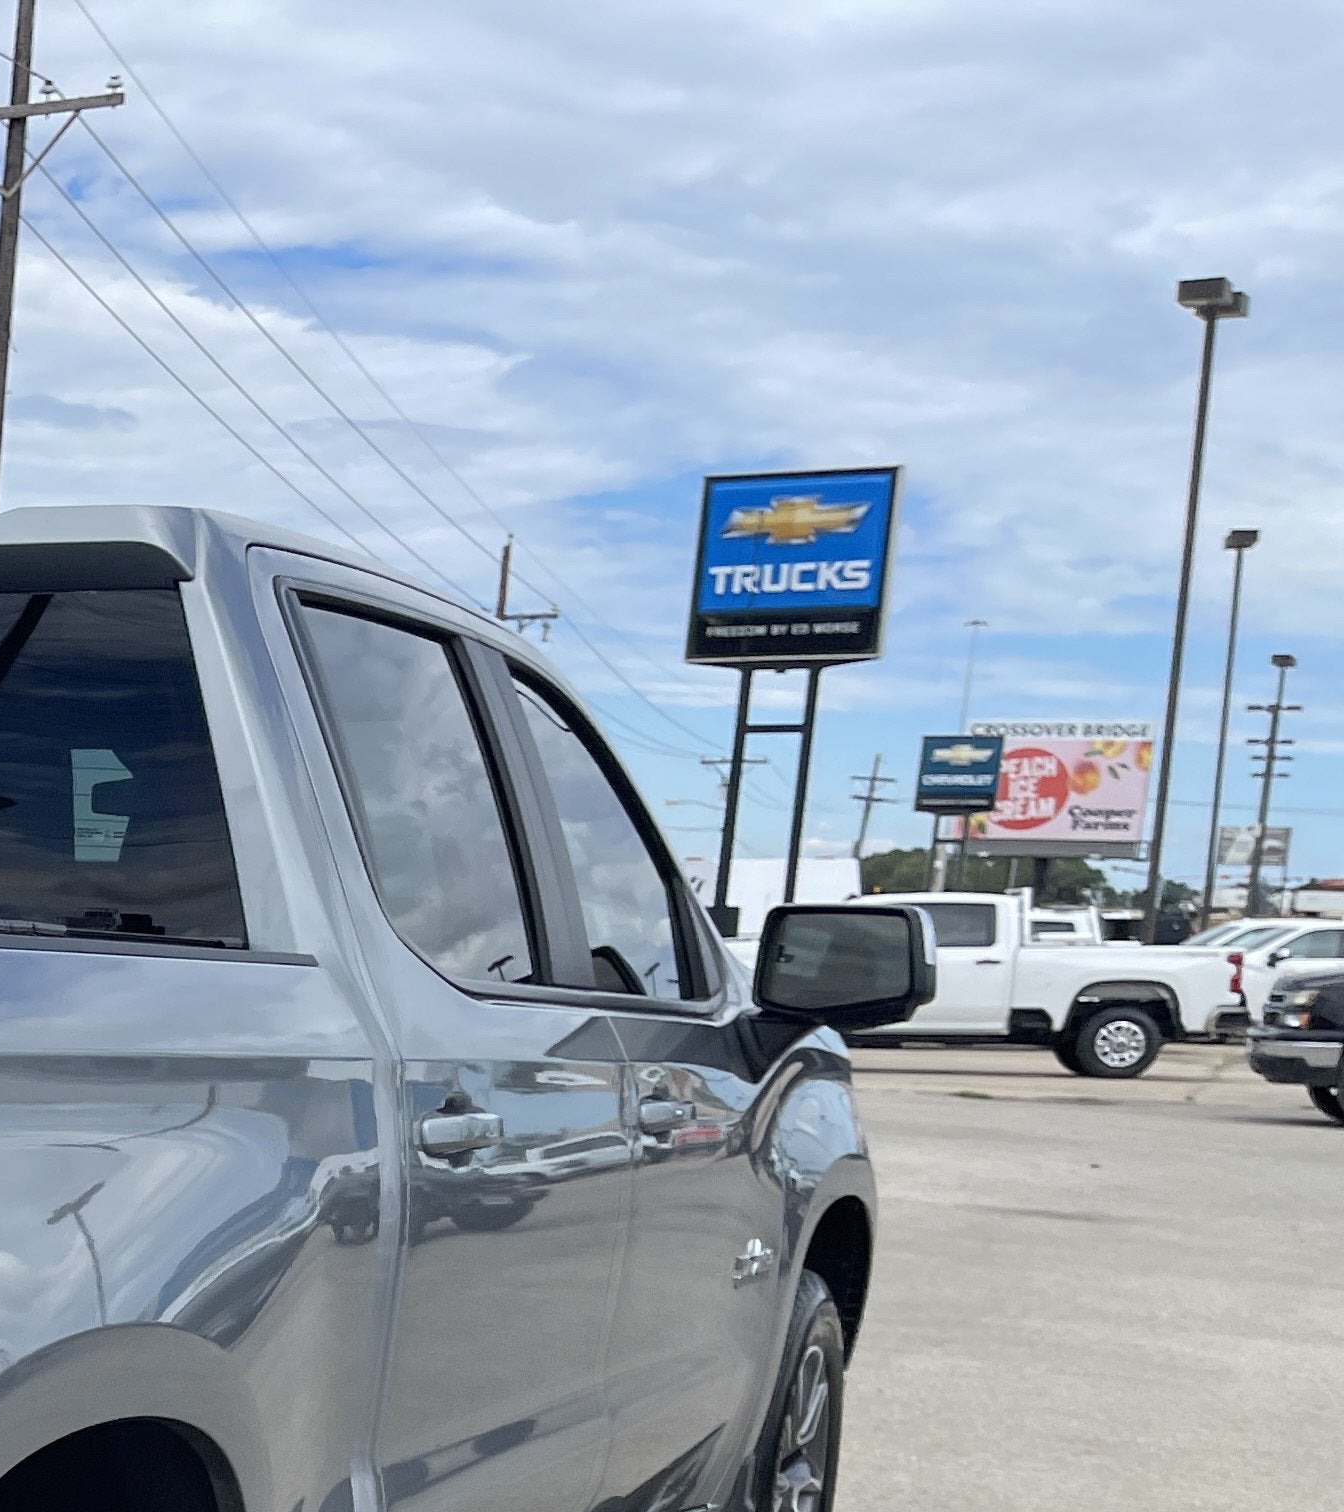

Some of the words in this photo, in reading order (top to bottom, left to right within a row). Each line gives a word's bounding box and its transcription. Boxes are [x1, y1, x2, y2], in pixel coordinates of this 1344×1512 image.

[708, 559, 871, 595] TRUCKS
[971, 722, 1077, 737] CROSSOVER
[1083, 722, 1151, 737] BRIDGE
